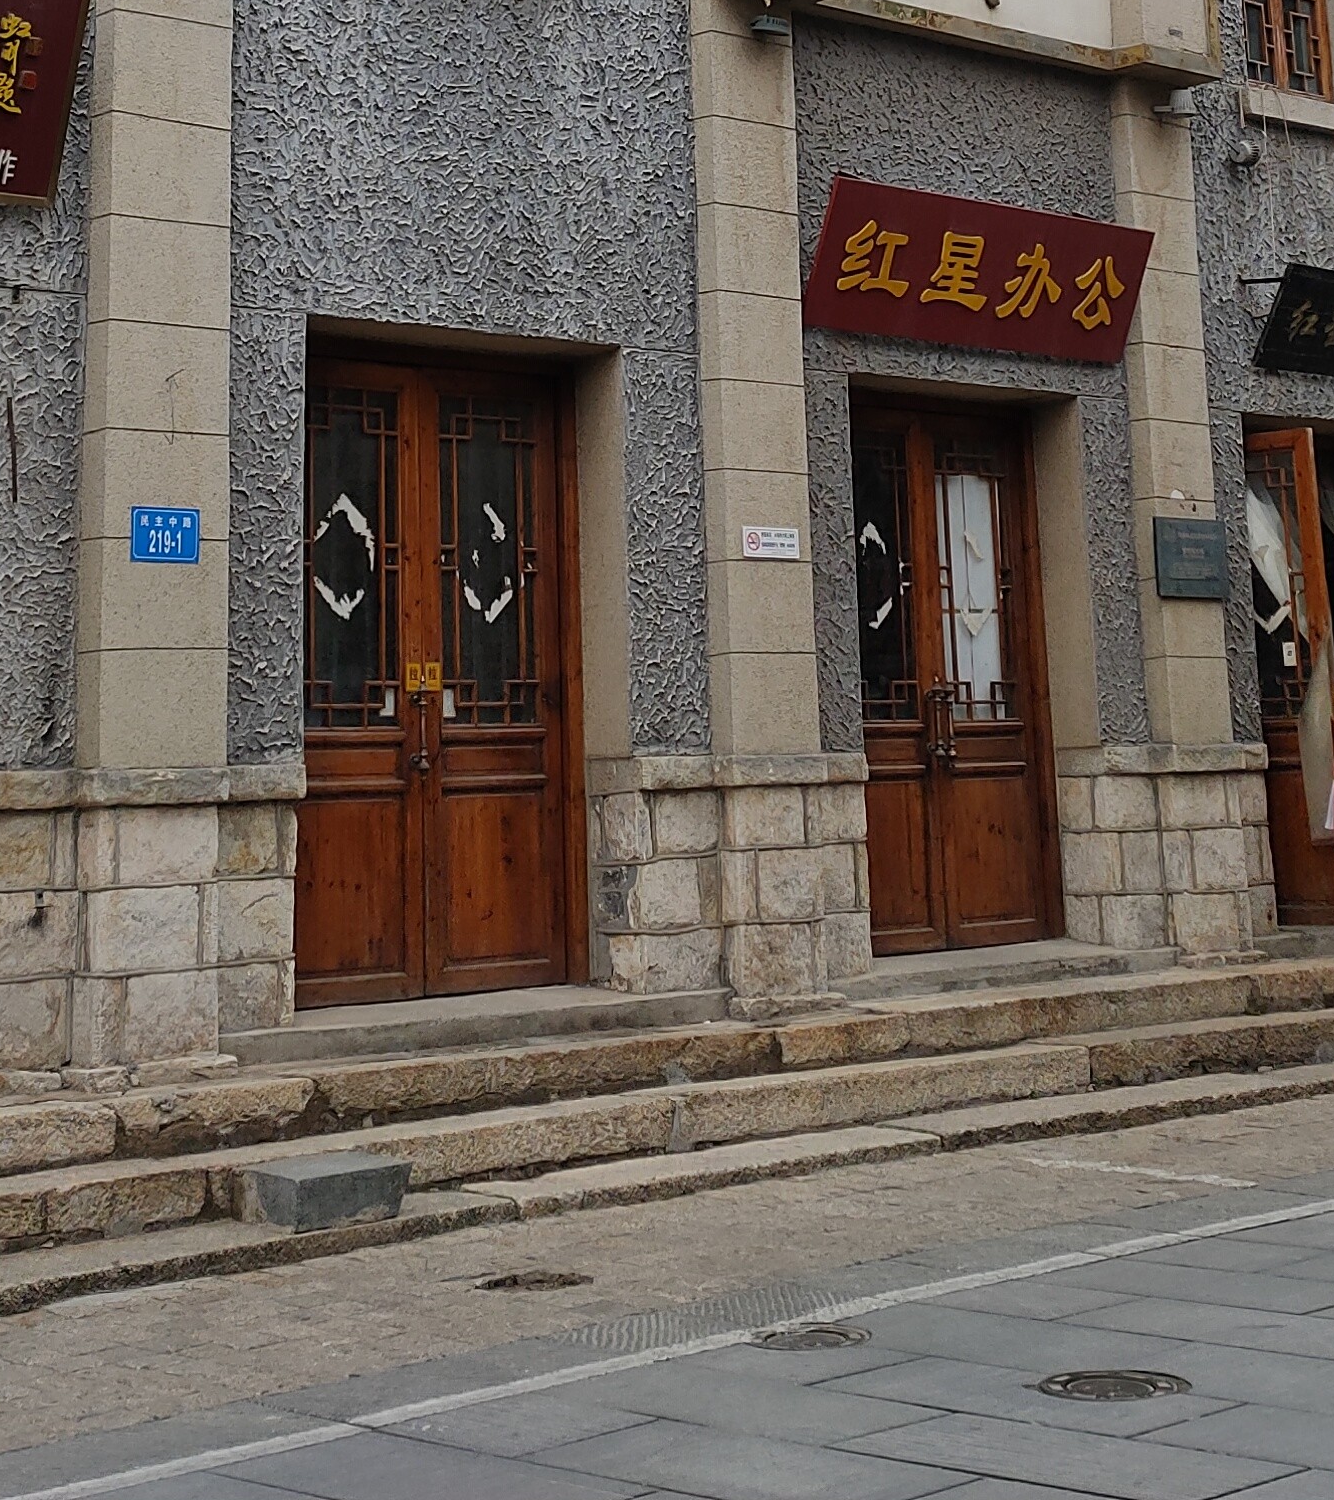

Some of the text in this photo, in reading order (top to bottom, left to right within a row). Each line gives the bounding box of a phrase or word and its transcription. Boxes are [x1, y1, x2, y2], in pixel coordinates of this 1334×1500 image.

[836, 219, 1126, 331] 红星办公
[140, 515, 191, 528] 民主中路
[148, 529, 182, 554] 219-1
